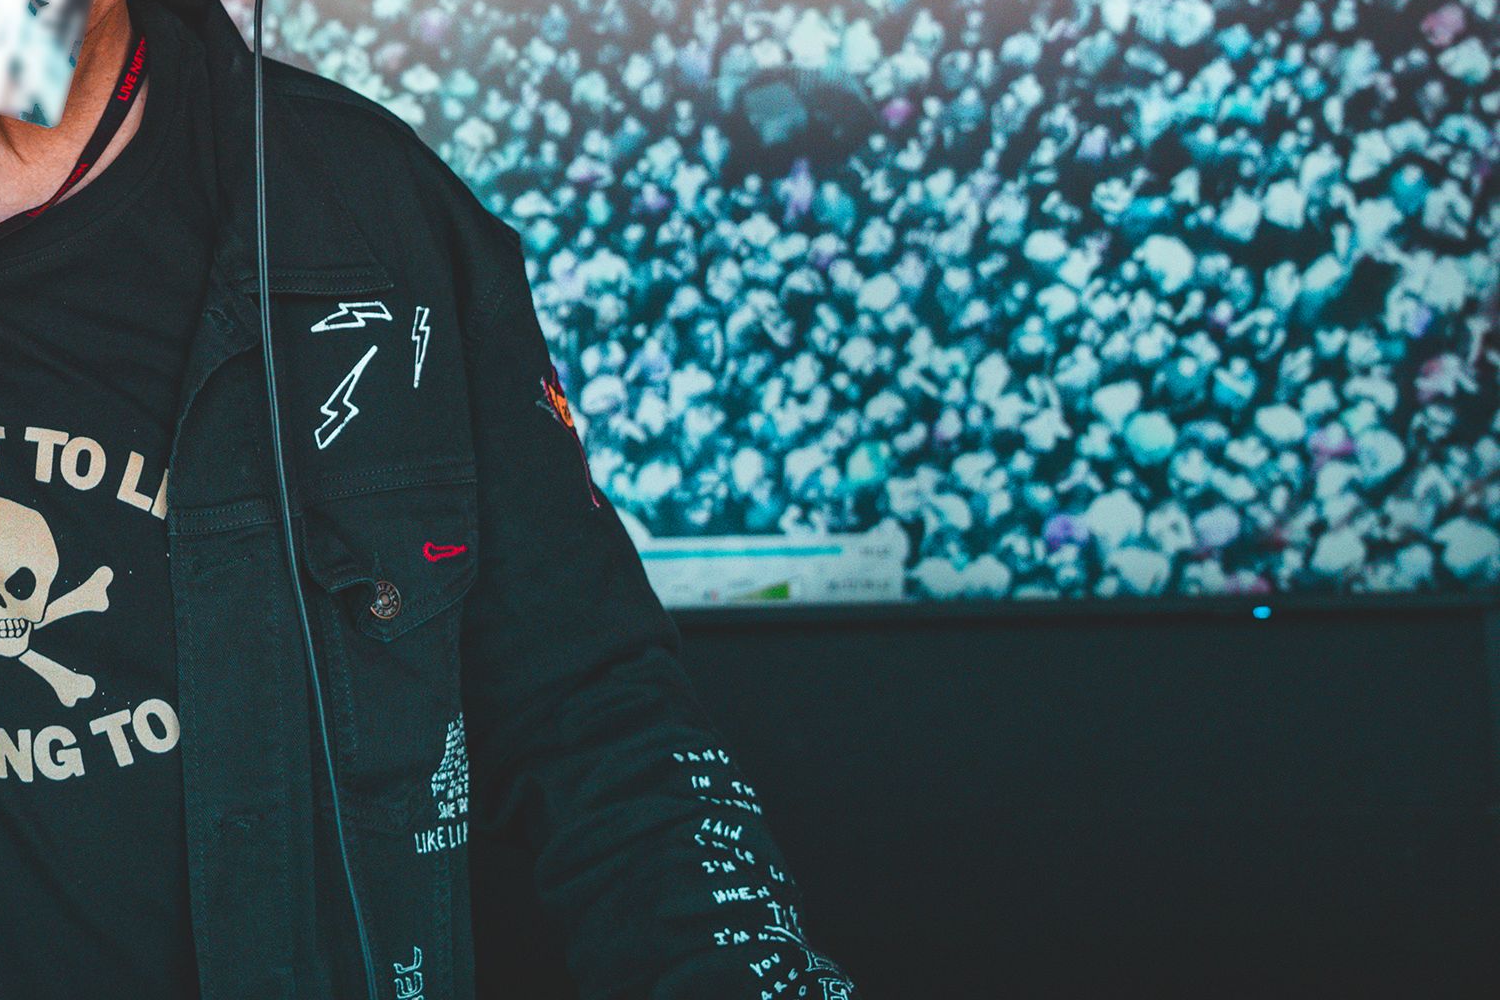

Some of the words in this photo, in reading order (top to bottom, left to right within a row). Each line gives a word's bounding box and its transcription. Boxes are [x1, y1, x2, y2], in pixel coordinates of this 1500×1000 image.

[117, 74, 137, 101] LIVE
[24, 426, 107, 491] TO
[89, 698, 181, 768] TO
[691, 775, 711, 789] IN
[414, 826, 446, 853] LIKE
